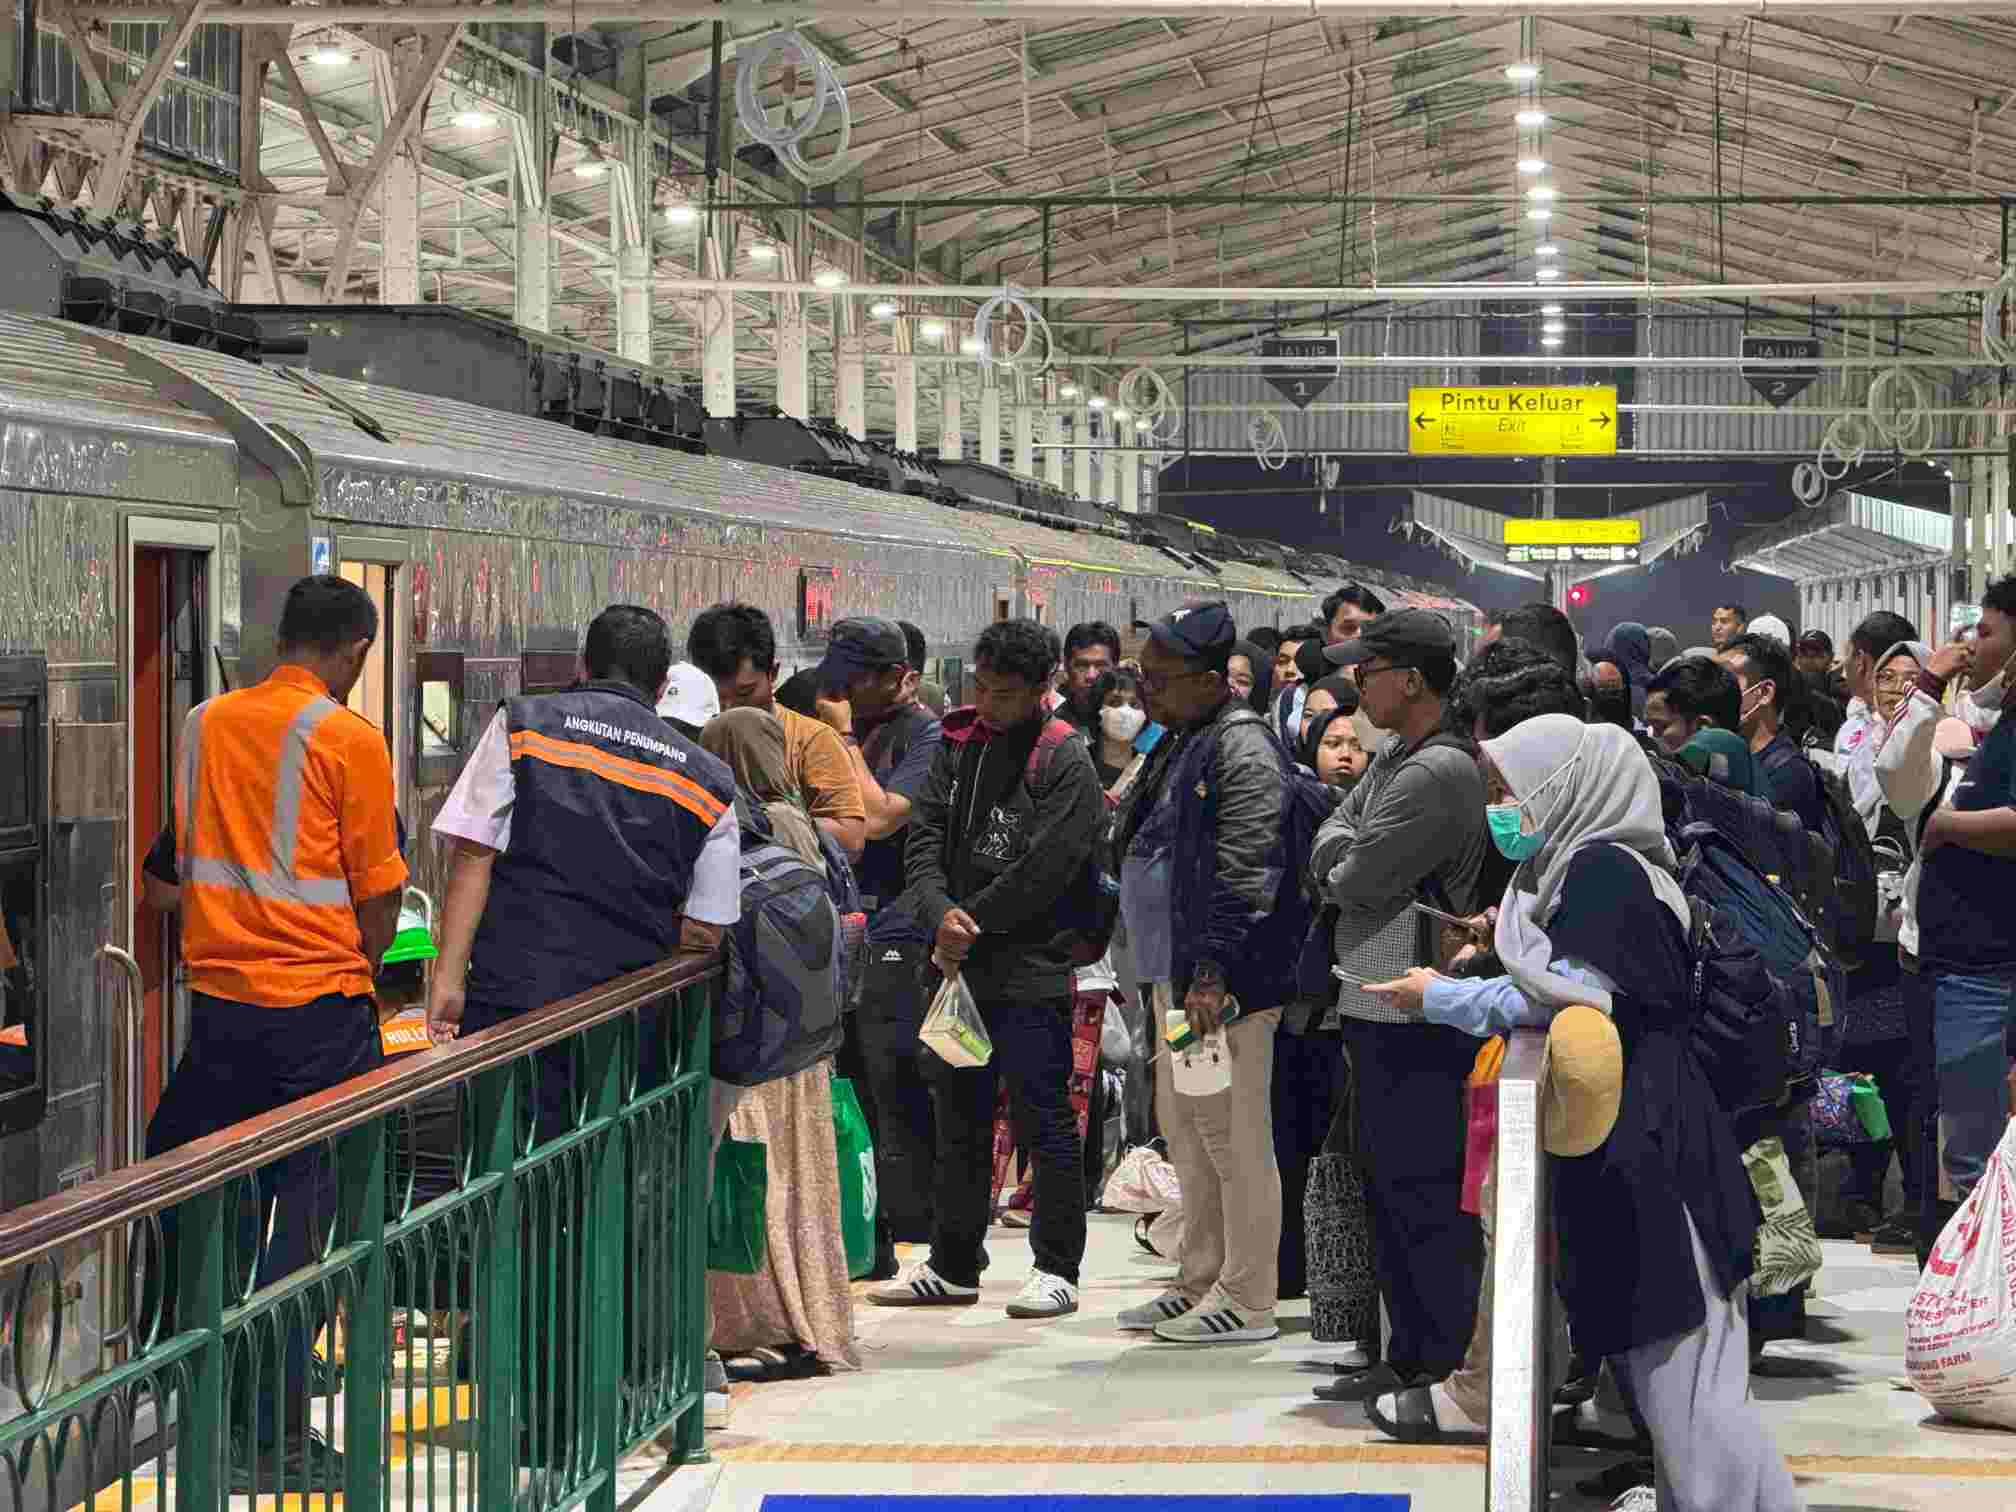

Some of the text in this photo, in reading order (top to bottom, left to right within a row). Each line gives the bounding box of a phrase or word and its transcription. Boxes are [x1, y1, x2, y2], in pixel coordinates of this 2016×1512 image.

[1296, 382, 1312, 396] 1
[1771, 381, 1785, 396] 2
[1441, 391, 1585, 411] Pintu Keluar
[1497, 417, 1527, 433] Exit
[563, 715, 688, 763] ANGKUTAN PENUMPANG
[1940, 1351, 1971, 1369] FARM
